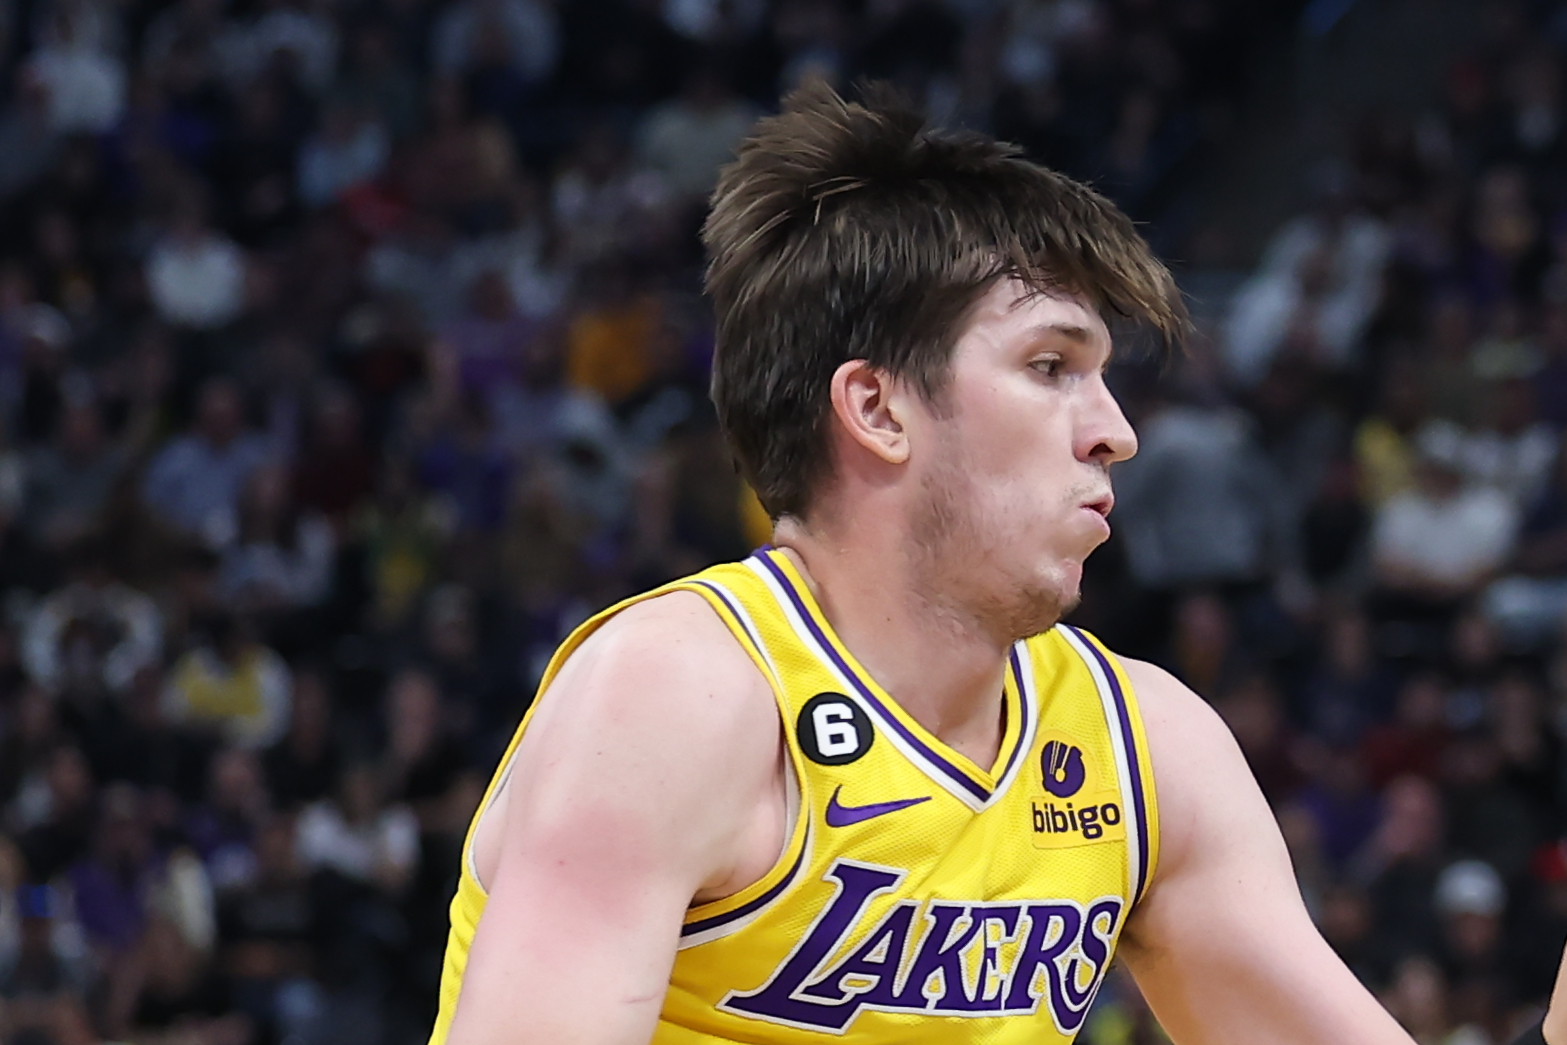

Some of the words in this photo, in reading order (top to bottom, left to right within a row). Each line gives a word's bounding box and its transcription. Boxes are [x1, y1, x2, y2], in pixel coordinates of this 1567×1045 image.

[811, 701, 861, 758] 6
[1031, 801, 1121, 840] bibigo
[715, 857, 1124, 1036] LAKERS
